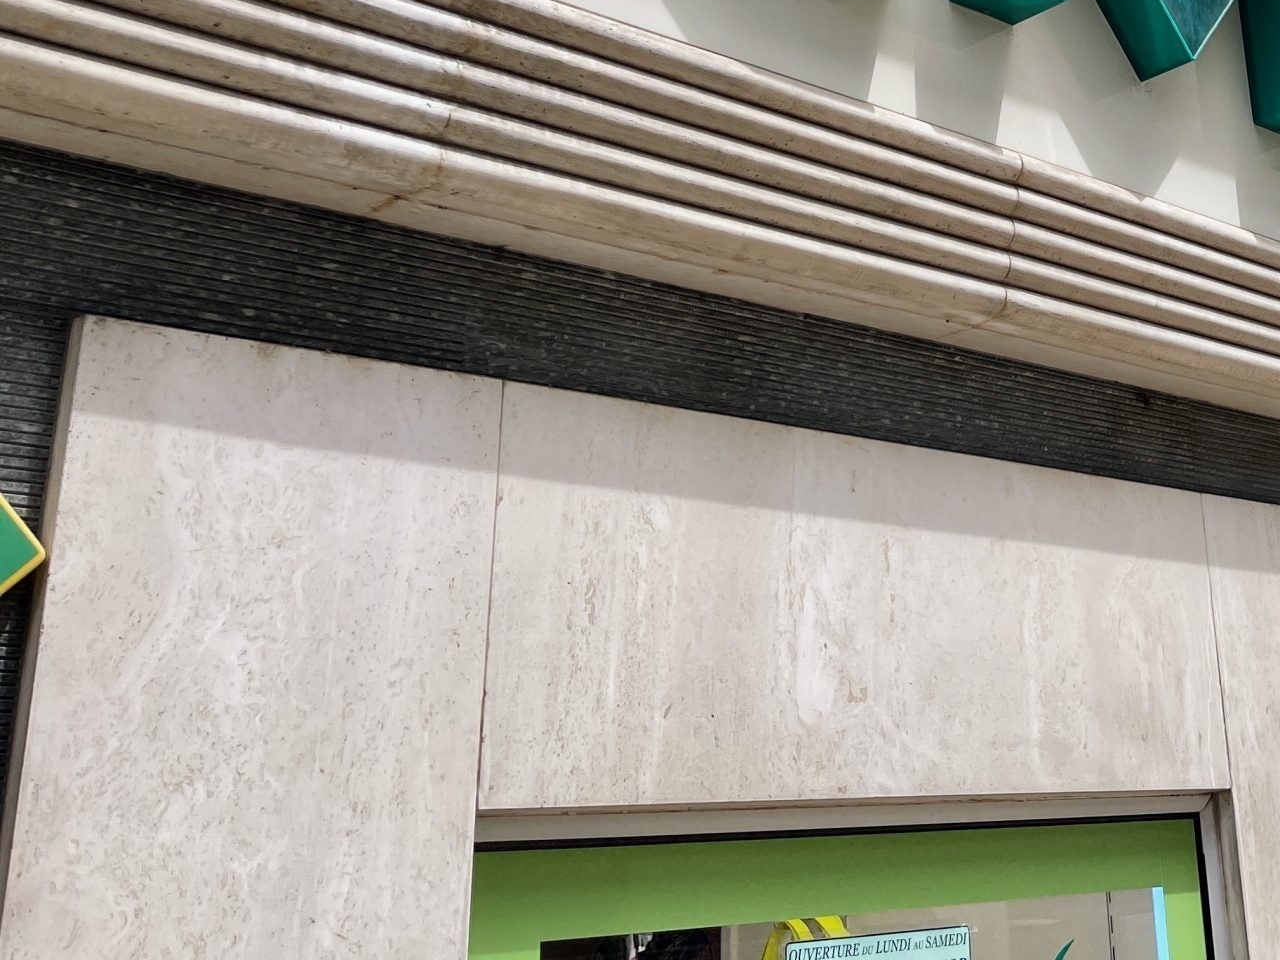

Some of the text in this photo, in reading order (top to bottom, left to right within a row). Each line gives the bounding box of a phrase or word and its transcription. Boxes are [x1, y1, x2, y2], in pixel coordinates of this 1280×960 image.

[788, 932, 967, 960] OUVERTURE DU LUNDI AU SAMEDI
